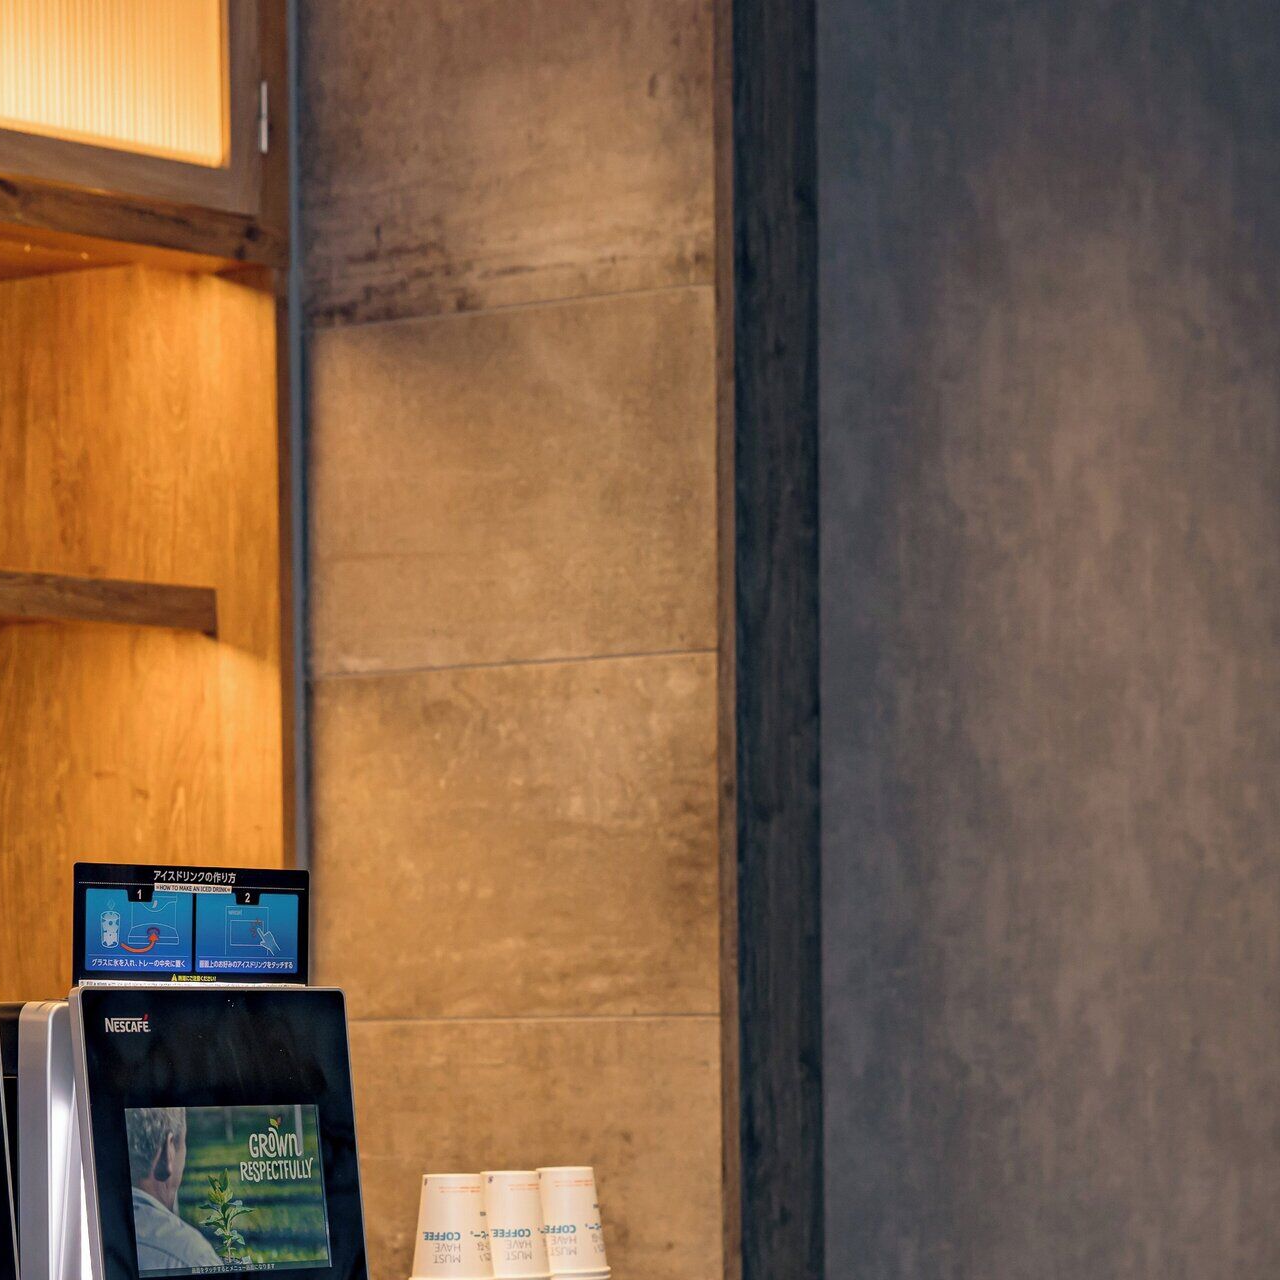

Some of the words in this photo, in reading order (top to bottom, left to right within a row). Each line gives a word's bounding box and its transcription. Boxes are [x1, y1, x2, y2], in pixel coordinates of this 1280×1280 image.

[153, 870, 236, 883] アイスドリンクの作り方
[137, 889, 142, 899] 1
[245, 893, 251, 903] 2
[249, 1127, 303, 1158] GROWN
[240, 1157, 313, 1183] RESPECTFULLY
[544, 1224, 577, 1234] COFFE
